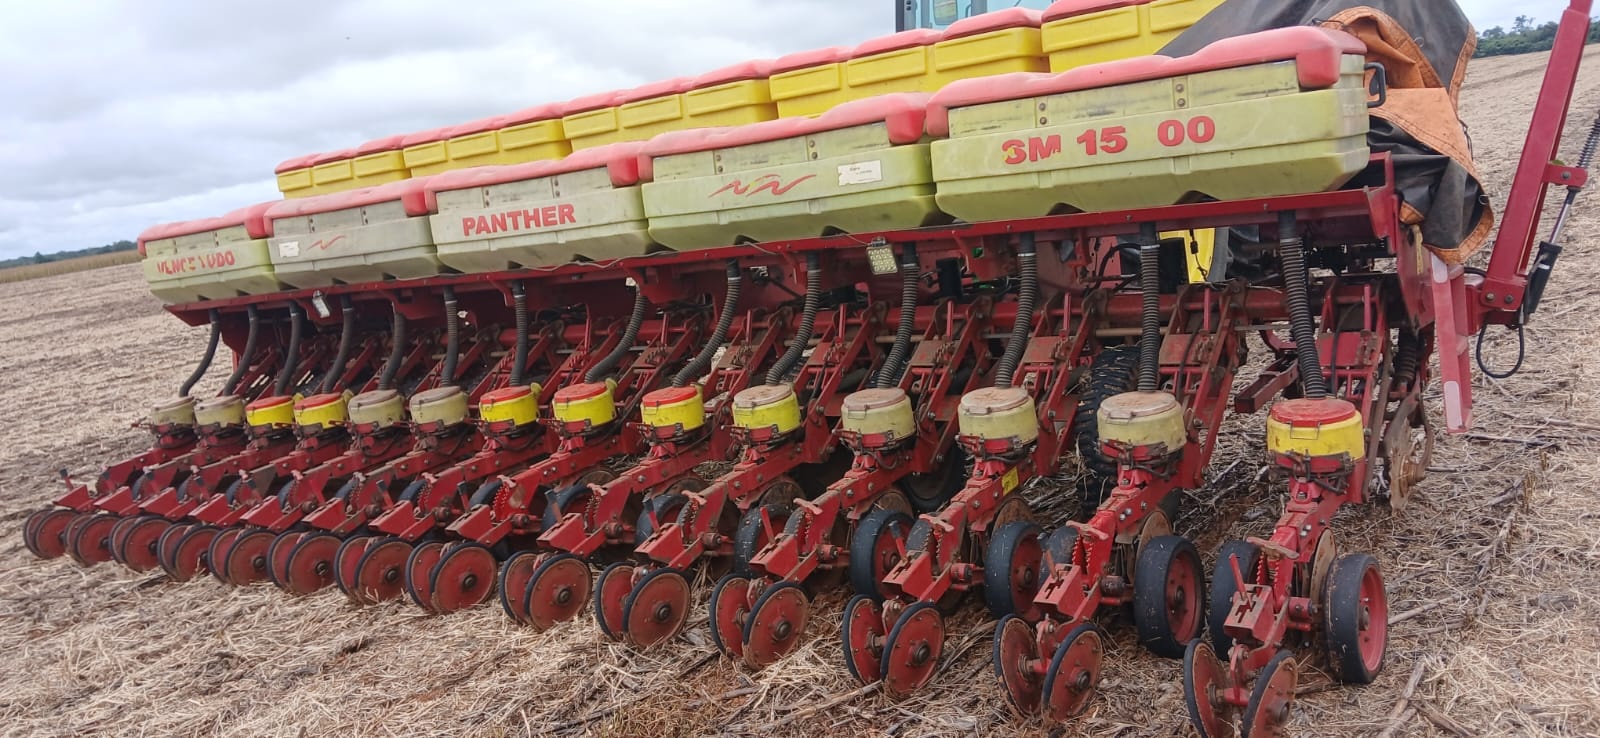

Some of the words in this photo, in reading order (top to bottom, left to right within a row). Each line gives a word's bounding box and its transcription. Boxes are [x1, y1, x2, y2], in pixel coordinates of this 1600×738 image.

[1001, 134, 1062, 165] SM
[1076, 125, 1128, 156] 15
[1157, 115, 1216, 147] 00
[462, 203, 577, 237] PANTHER
